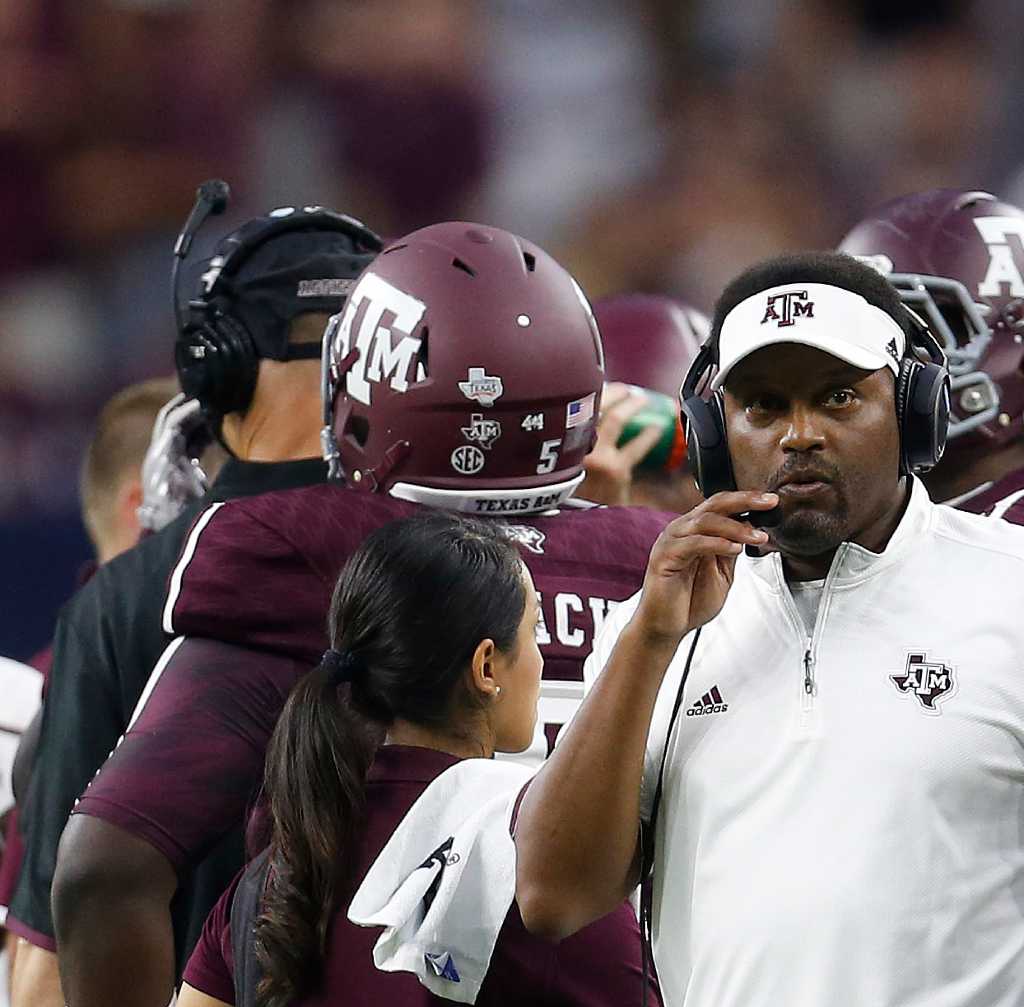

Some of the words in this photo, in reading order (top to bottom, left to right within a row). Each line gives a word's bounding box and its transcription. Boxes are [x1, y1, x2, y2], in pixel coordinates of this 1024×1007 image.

[453, 446, 484, 473] SEC
[536, 438, 562, 475] 5
[475, 496, 531, 511] TEXAS
[686, 702, 728, 717] adidas
